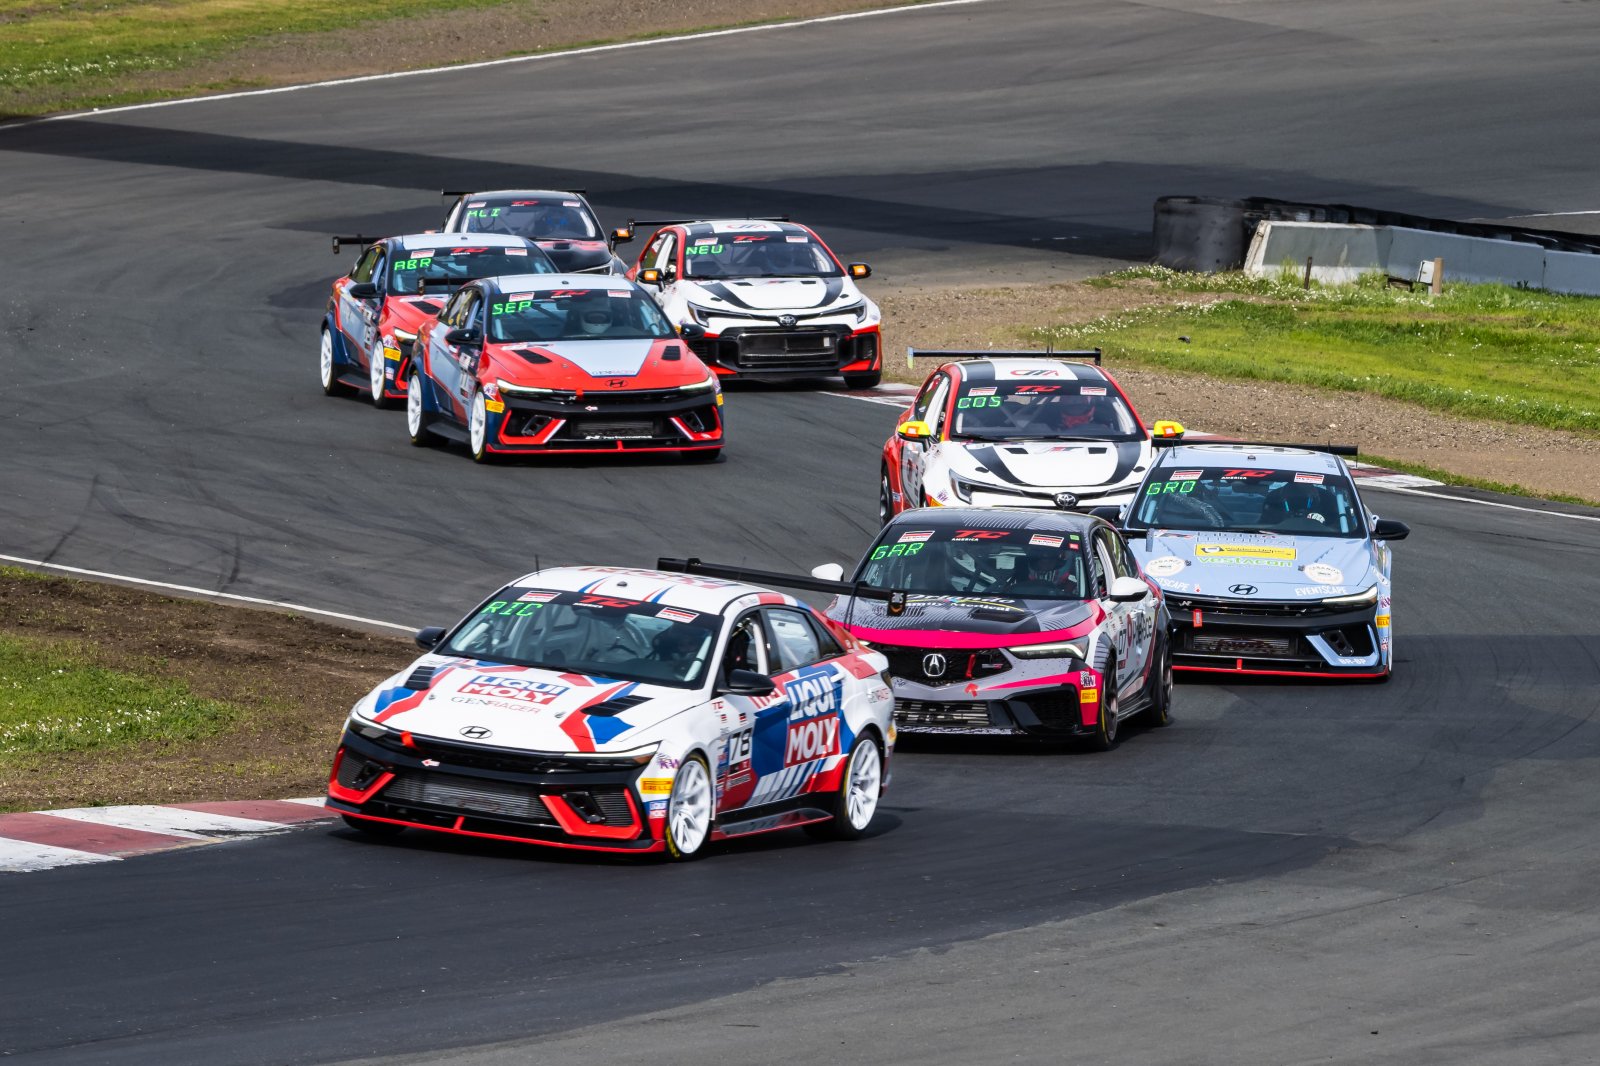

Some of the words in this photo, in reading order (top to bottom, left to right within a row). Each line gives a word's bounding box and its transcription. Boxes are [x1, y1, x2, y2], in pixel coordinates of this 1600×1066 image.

[686, 245, 723, 255] NEU
[394, 257, 432, 271] ABR
[493, 301, 531, 315] SEP
[957, 396, 1001, 409] COS
[1223, 469, 1276, 478] TC
[1147, 481, 1196, 495] GRO
[954, 530, 1011, 539] TC
[870, 542, 925, 561] GAR
[481, 601, 543, 616] RIC
[475, 676, 568, 695] LIQUI
[462, 684, 557, 703] MOLY
[787, 676, 836, 720] LIQUI
[450, 696, 541, 714] GENRACER
[731, 728, 753, 760] 78
[786, 717, 837, 763] MOLY
